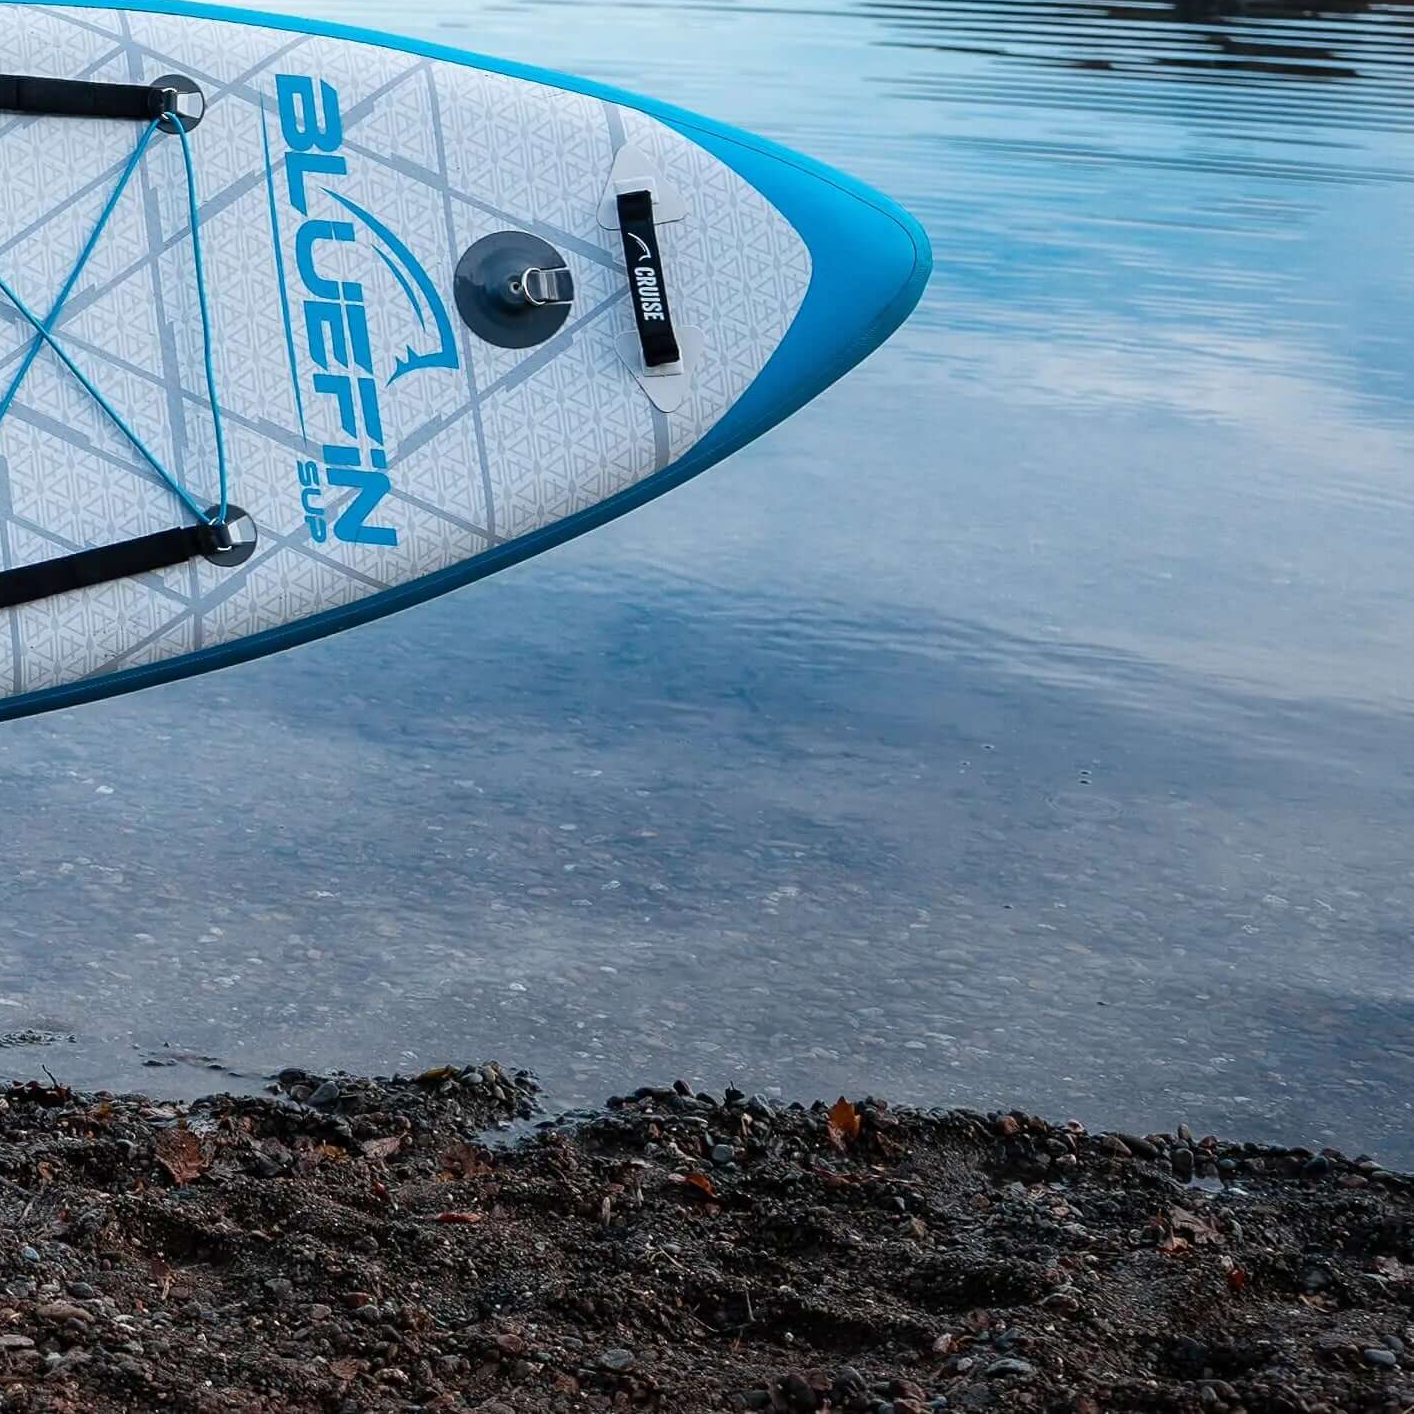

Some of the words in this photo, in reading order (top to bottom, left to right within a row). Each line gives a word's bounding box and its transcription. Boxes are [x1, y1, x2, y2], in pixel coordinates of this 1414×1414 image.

[275, 73, 398, 547] BLUEFIN
[634, 266, 665, 321] CRUISE
[296, 460, 327, 543] SUP
